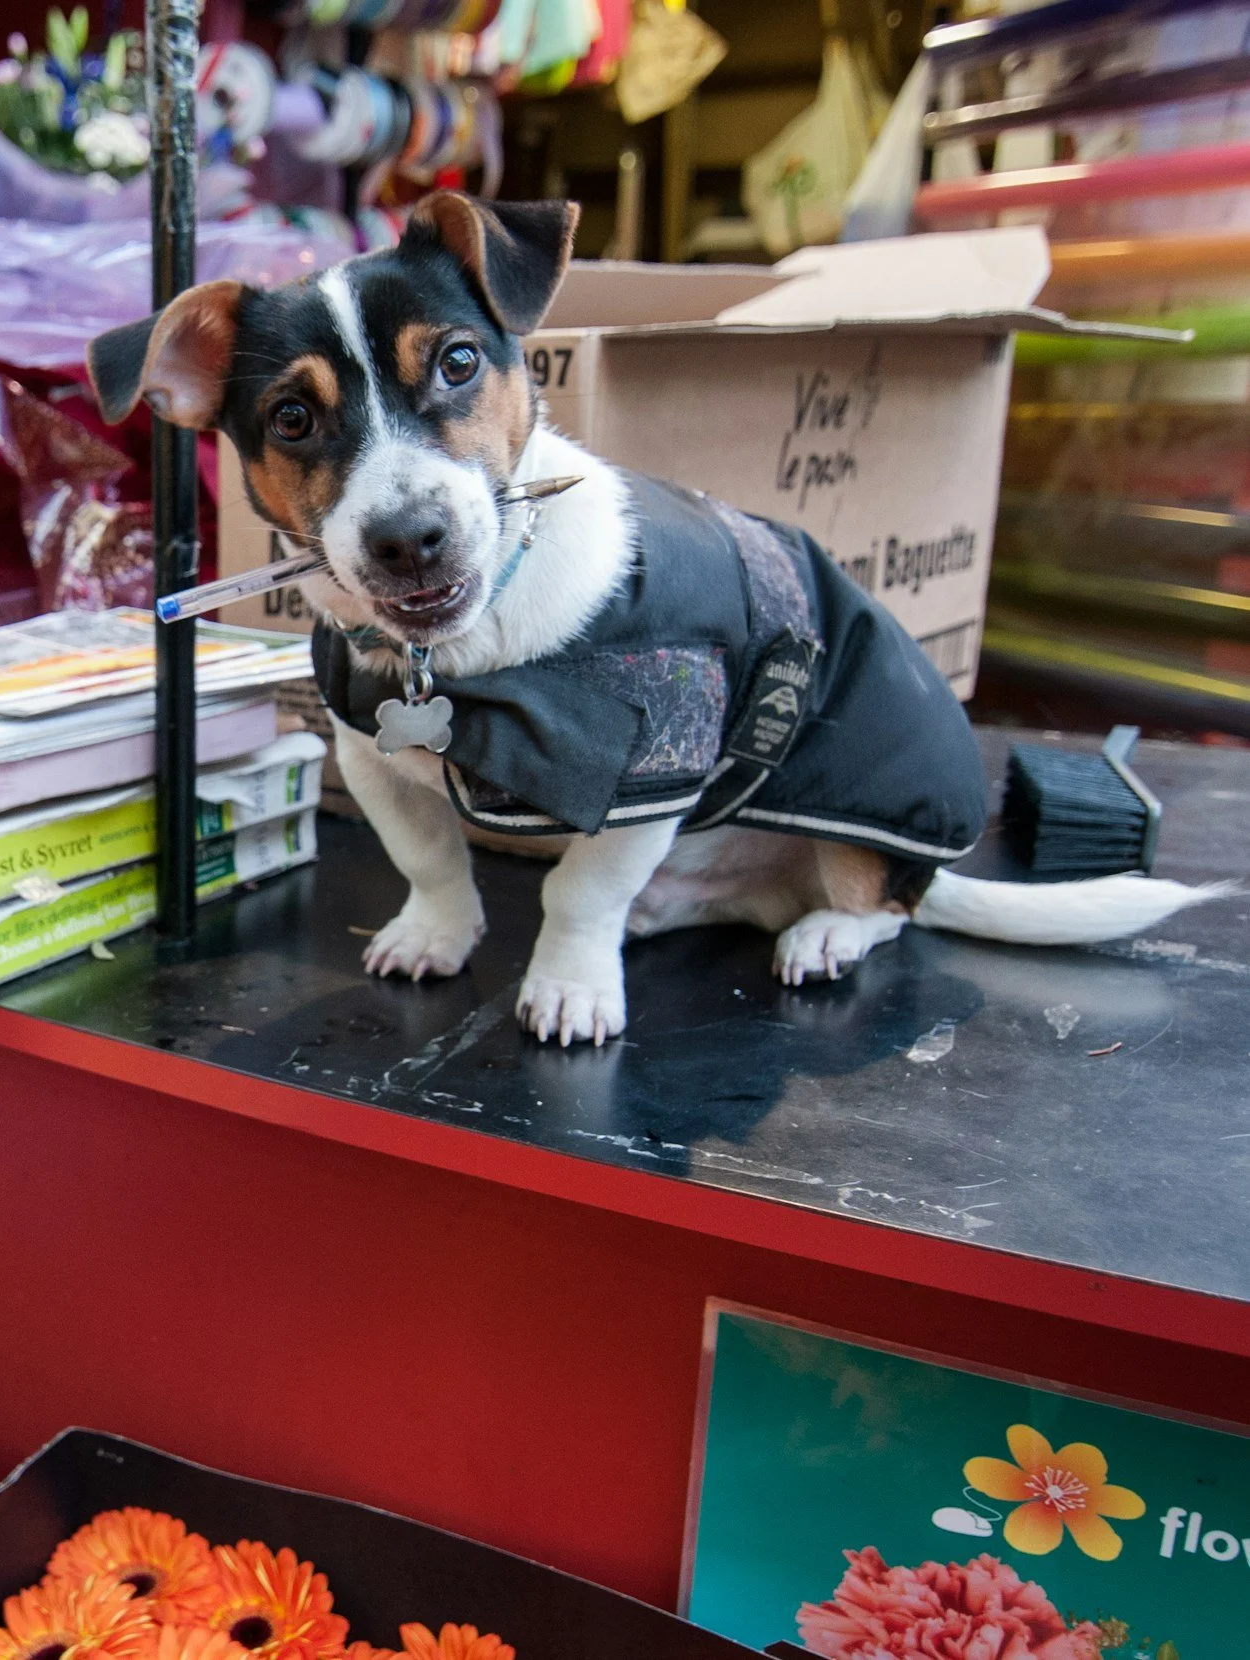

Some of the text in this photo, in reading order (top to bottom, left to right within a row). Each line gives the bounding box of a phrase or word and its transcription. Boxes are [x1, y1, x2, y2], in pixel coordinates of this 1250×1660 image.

[523, 348, 573, 388] 97
[884, 528, 975, 594] Baguette
[19, 847, 35, 869] &
[37, 833, 95, 868] Syvret
